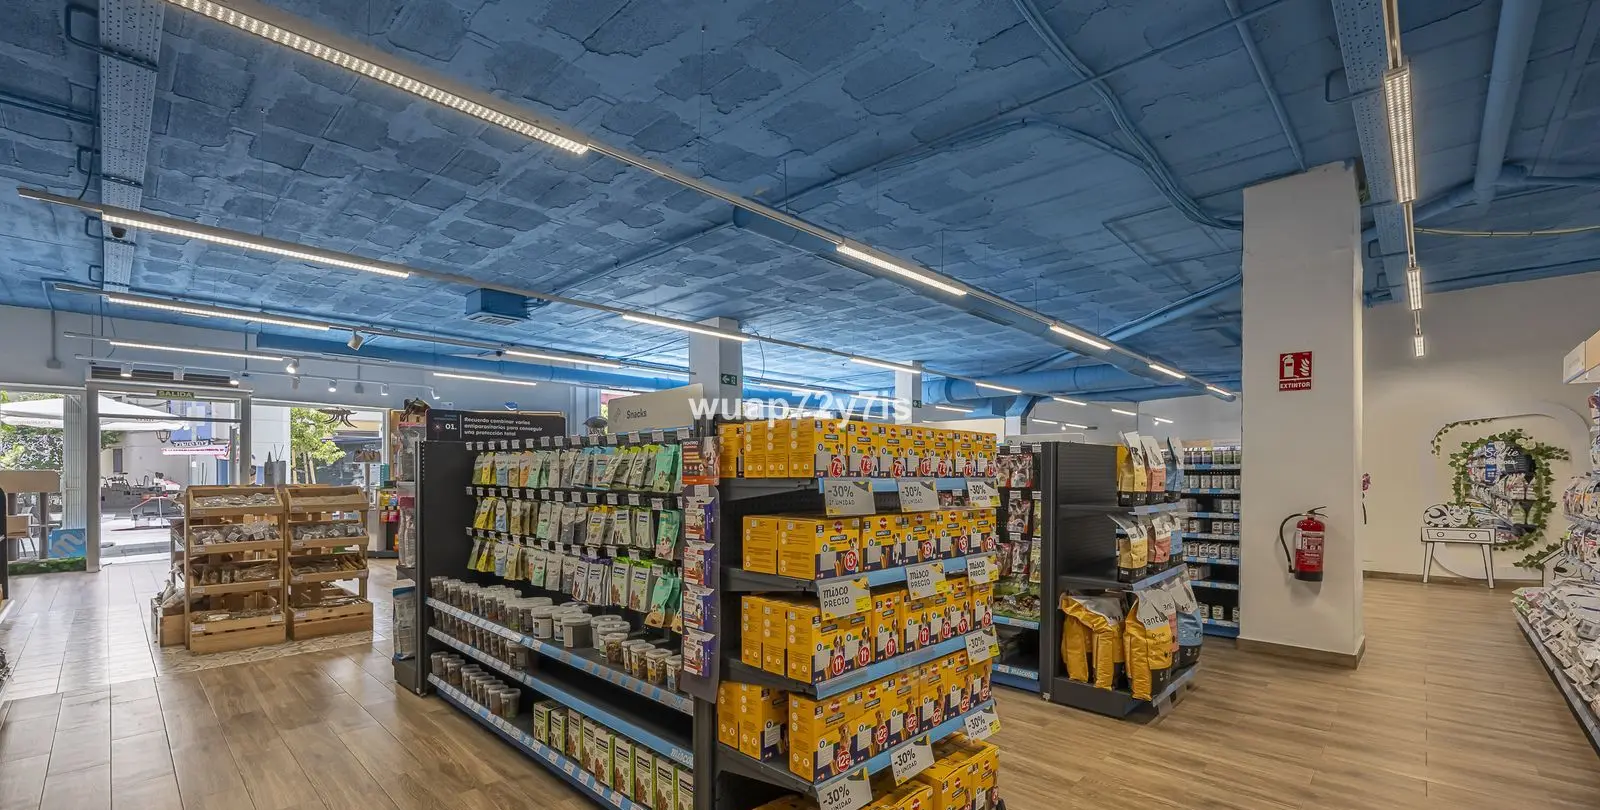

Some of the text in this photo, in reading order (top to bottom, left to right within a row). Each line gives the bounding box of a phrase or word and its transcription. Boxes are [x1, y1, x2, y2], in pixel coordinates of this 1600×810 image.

[158, 390, 193, 398] SALIDA
[626, 410, 647, 419] Snacks
[828, 485, 854, 497] -30%
[901, 486, 922, 496] -30%
[970, 485, 986, 494] -30%
[969, 560, 985, 570] misco
[909, 569, 929, 581] misco
[970, 568, 986, 577] PRECIO
[911, 578, 930, 589] PRECIO
[822, 585, 848, 599] misco
[824, 596, 850, 608] PRECIO
[969, 636, 985, 649] -30%
[968, 715, 985, 729] -30%
[894, 748, 916, 766] -30%
[822, 784, 850, 805] -30%
